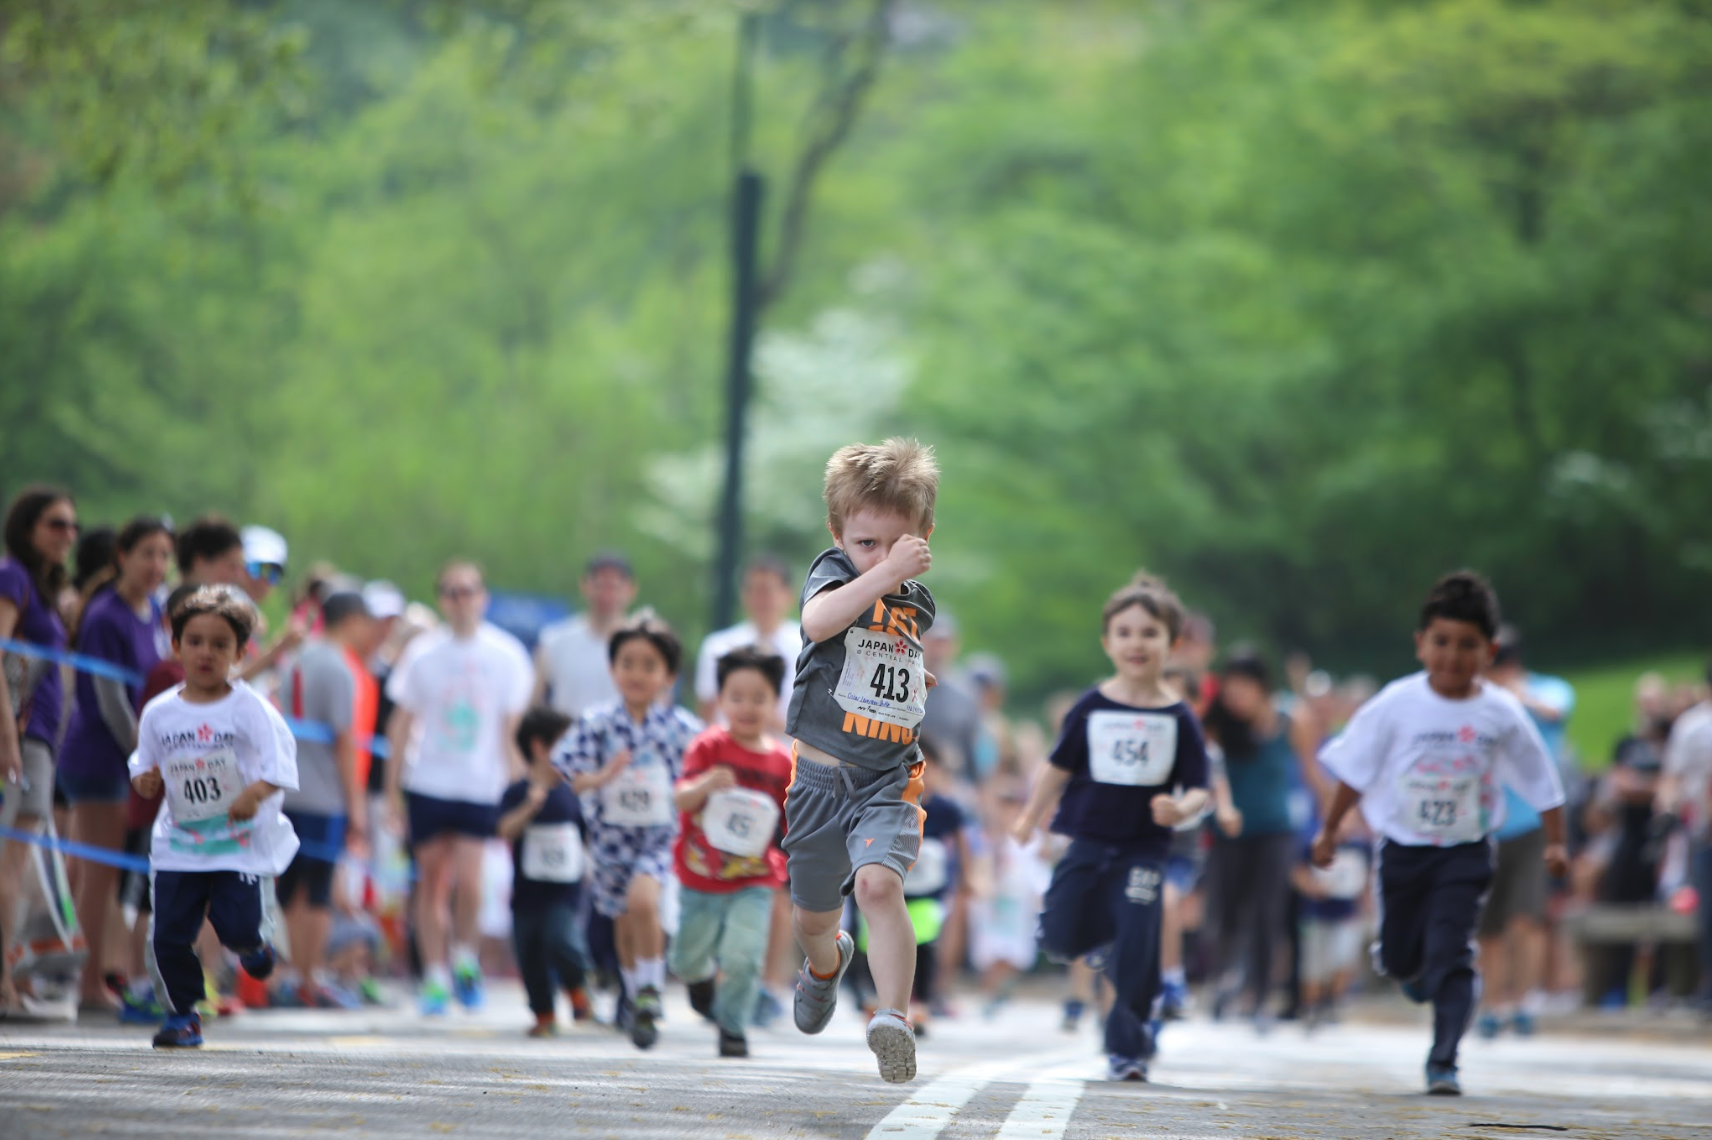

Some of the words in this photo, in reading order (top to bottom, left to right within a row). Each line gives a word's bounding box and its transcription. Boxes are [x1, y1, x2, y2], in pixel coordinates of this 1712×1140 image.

[858, 639, 894, 653] JAPAN
[870, 663, 910, 703] 413
[161, 731, 195, 746] JAPAN
[1112, 739, 1149, 768] 454
[184, 777, 221, 805] 403
